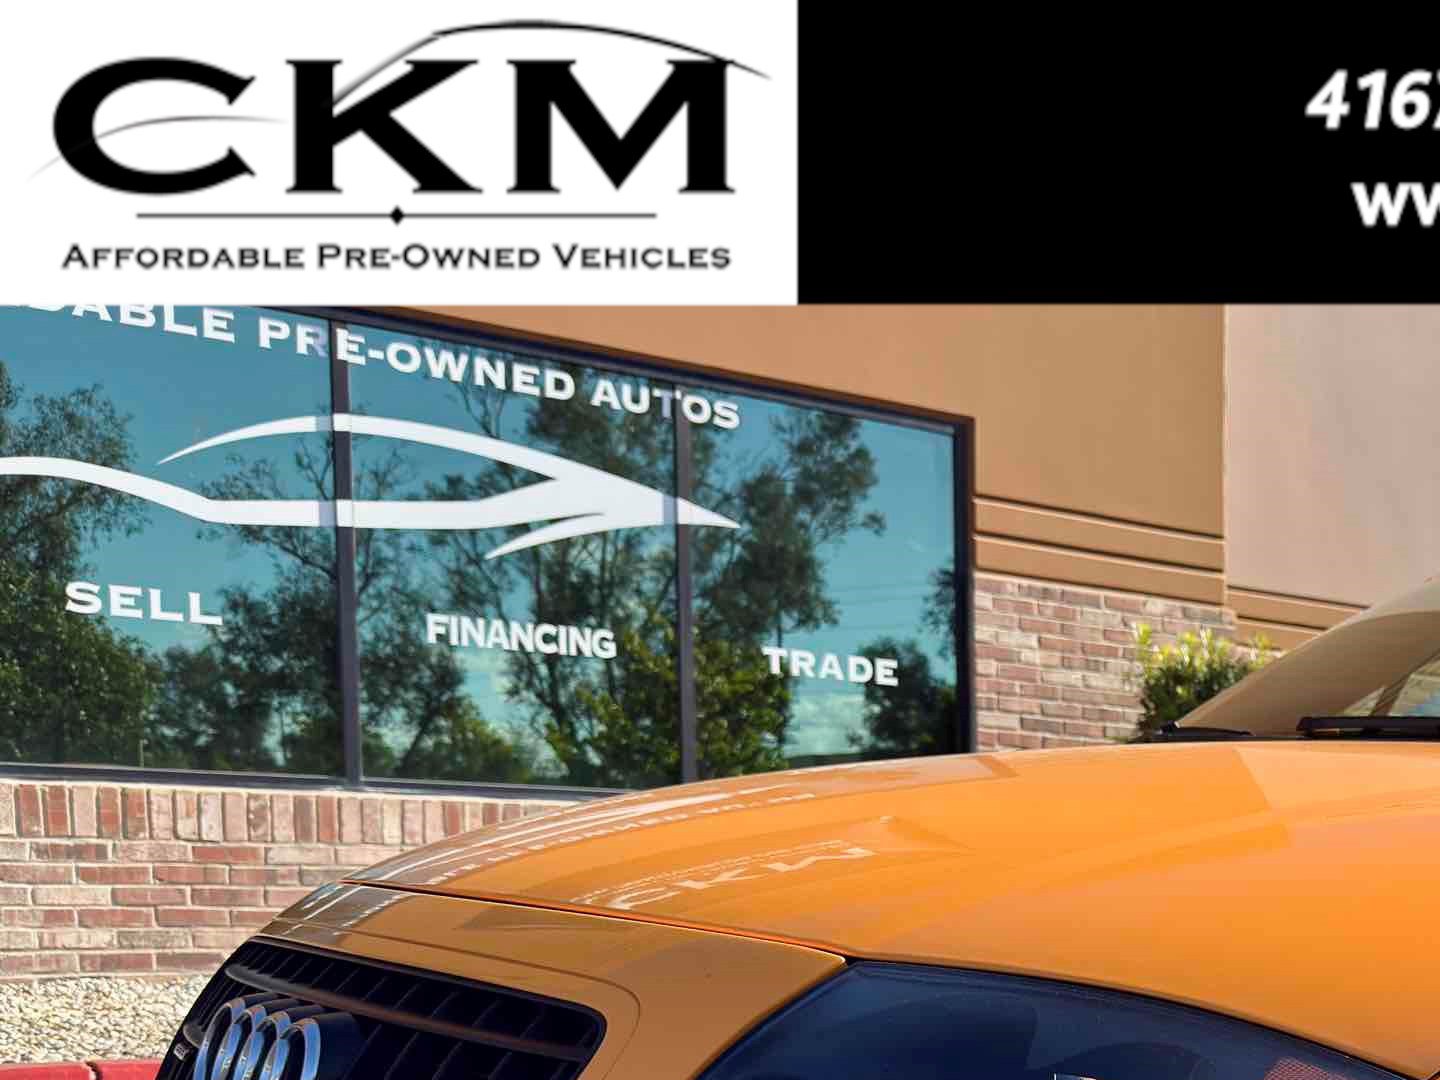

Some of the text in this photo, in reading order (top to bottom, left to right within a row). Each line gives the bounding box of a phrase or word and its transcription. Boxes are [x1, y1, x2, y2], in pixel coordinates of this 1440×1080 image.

[258, 317, 576, 401] PRE-OWNED
[590, 379, 741, 429] AUTOS
[64, 580, 224, 626] SELL
[426, 612, 618, 660] FINANCING
[762, 645, 899, 687] TRADE
